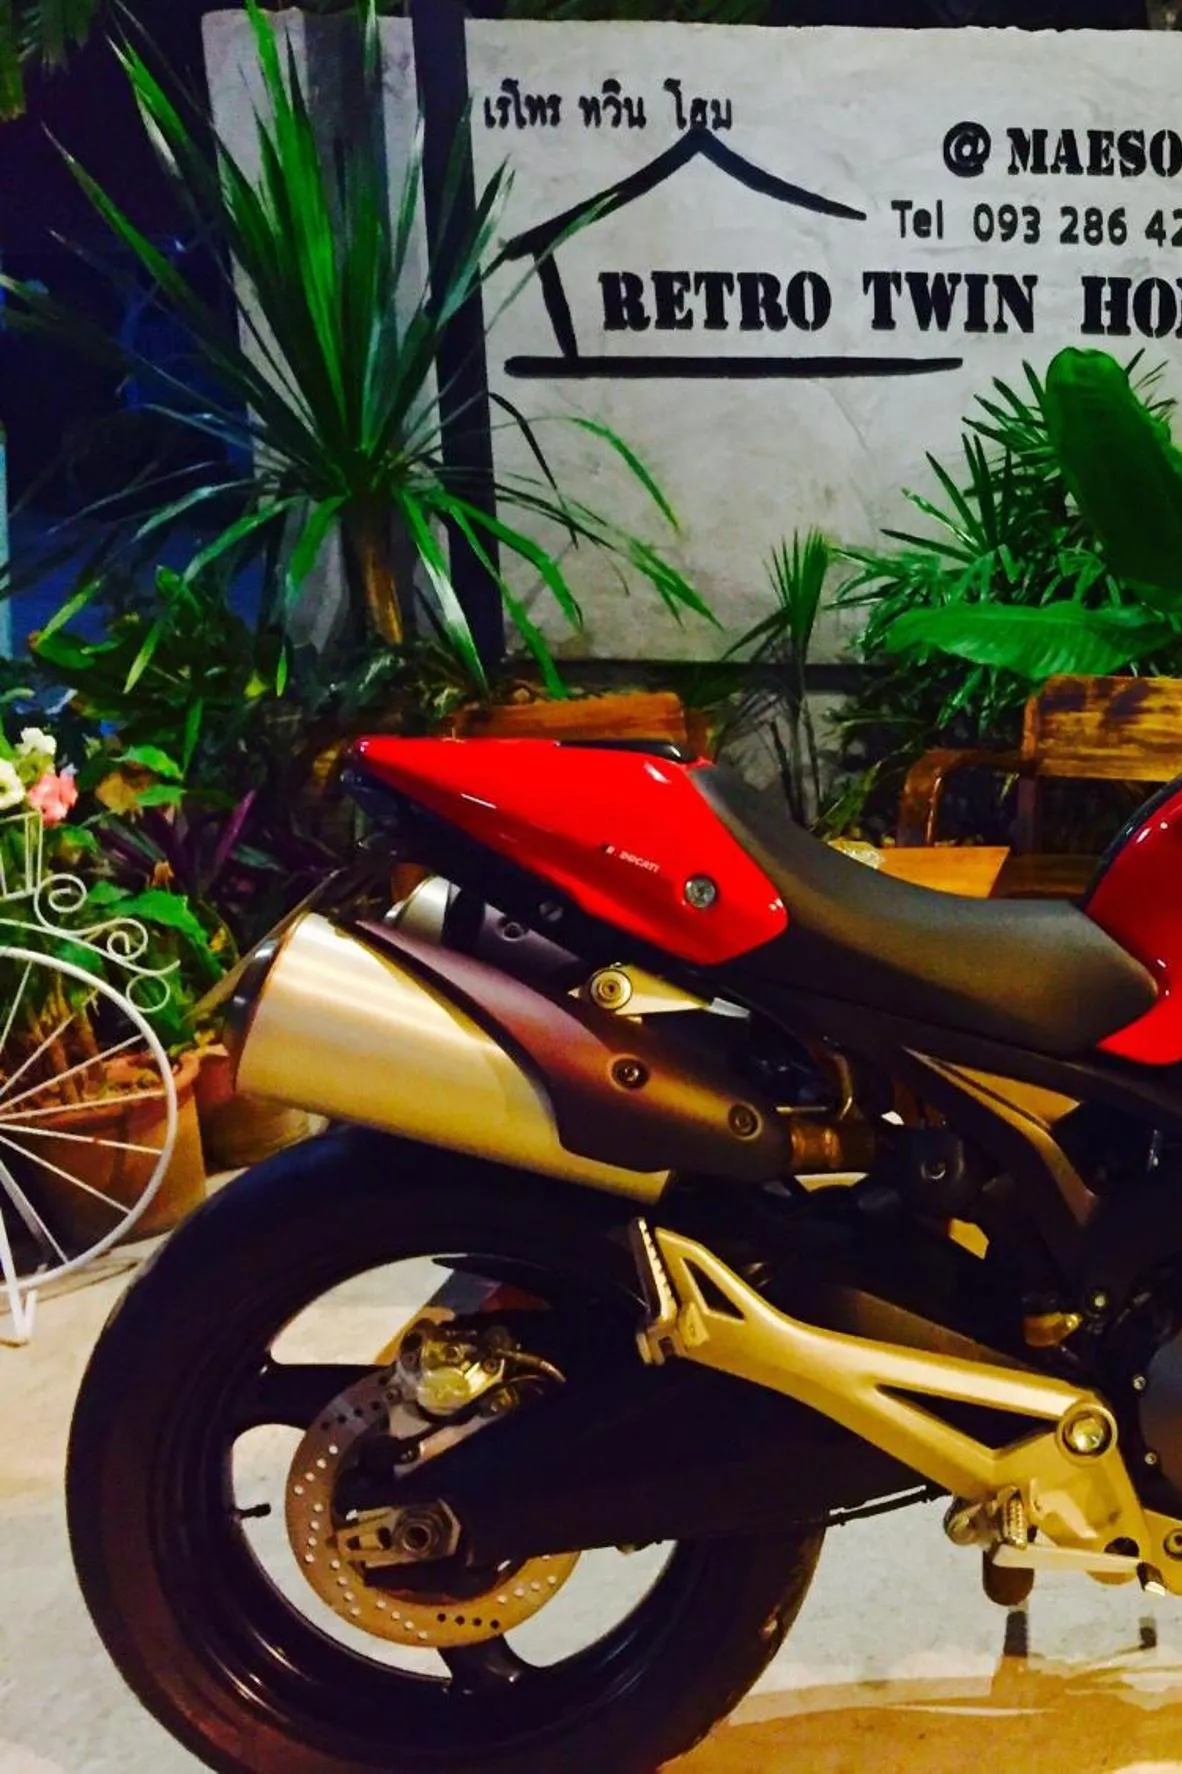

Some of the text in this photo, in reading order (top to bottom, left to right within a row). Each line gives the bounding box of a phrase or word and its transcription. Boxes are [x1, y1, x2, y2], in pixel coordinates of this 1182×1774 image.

[484, 78, 562, 129] เรโทร
[579, 78, 647, 129] ทวิน
[943, 121, 991, 177] @
[891, 199, 943, 239] Tel
[973, 203, 1041, 244] 093
[1060, 206, 1127, 246] 286
[598, 271, 831, 332] RETRO
[863, 271, 1038, 333] TWIN
